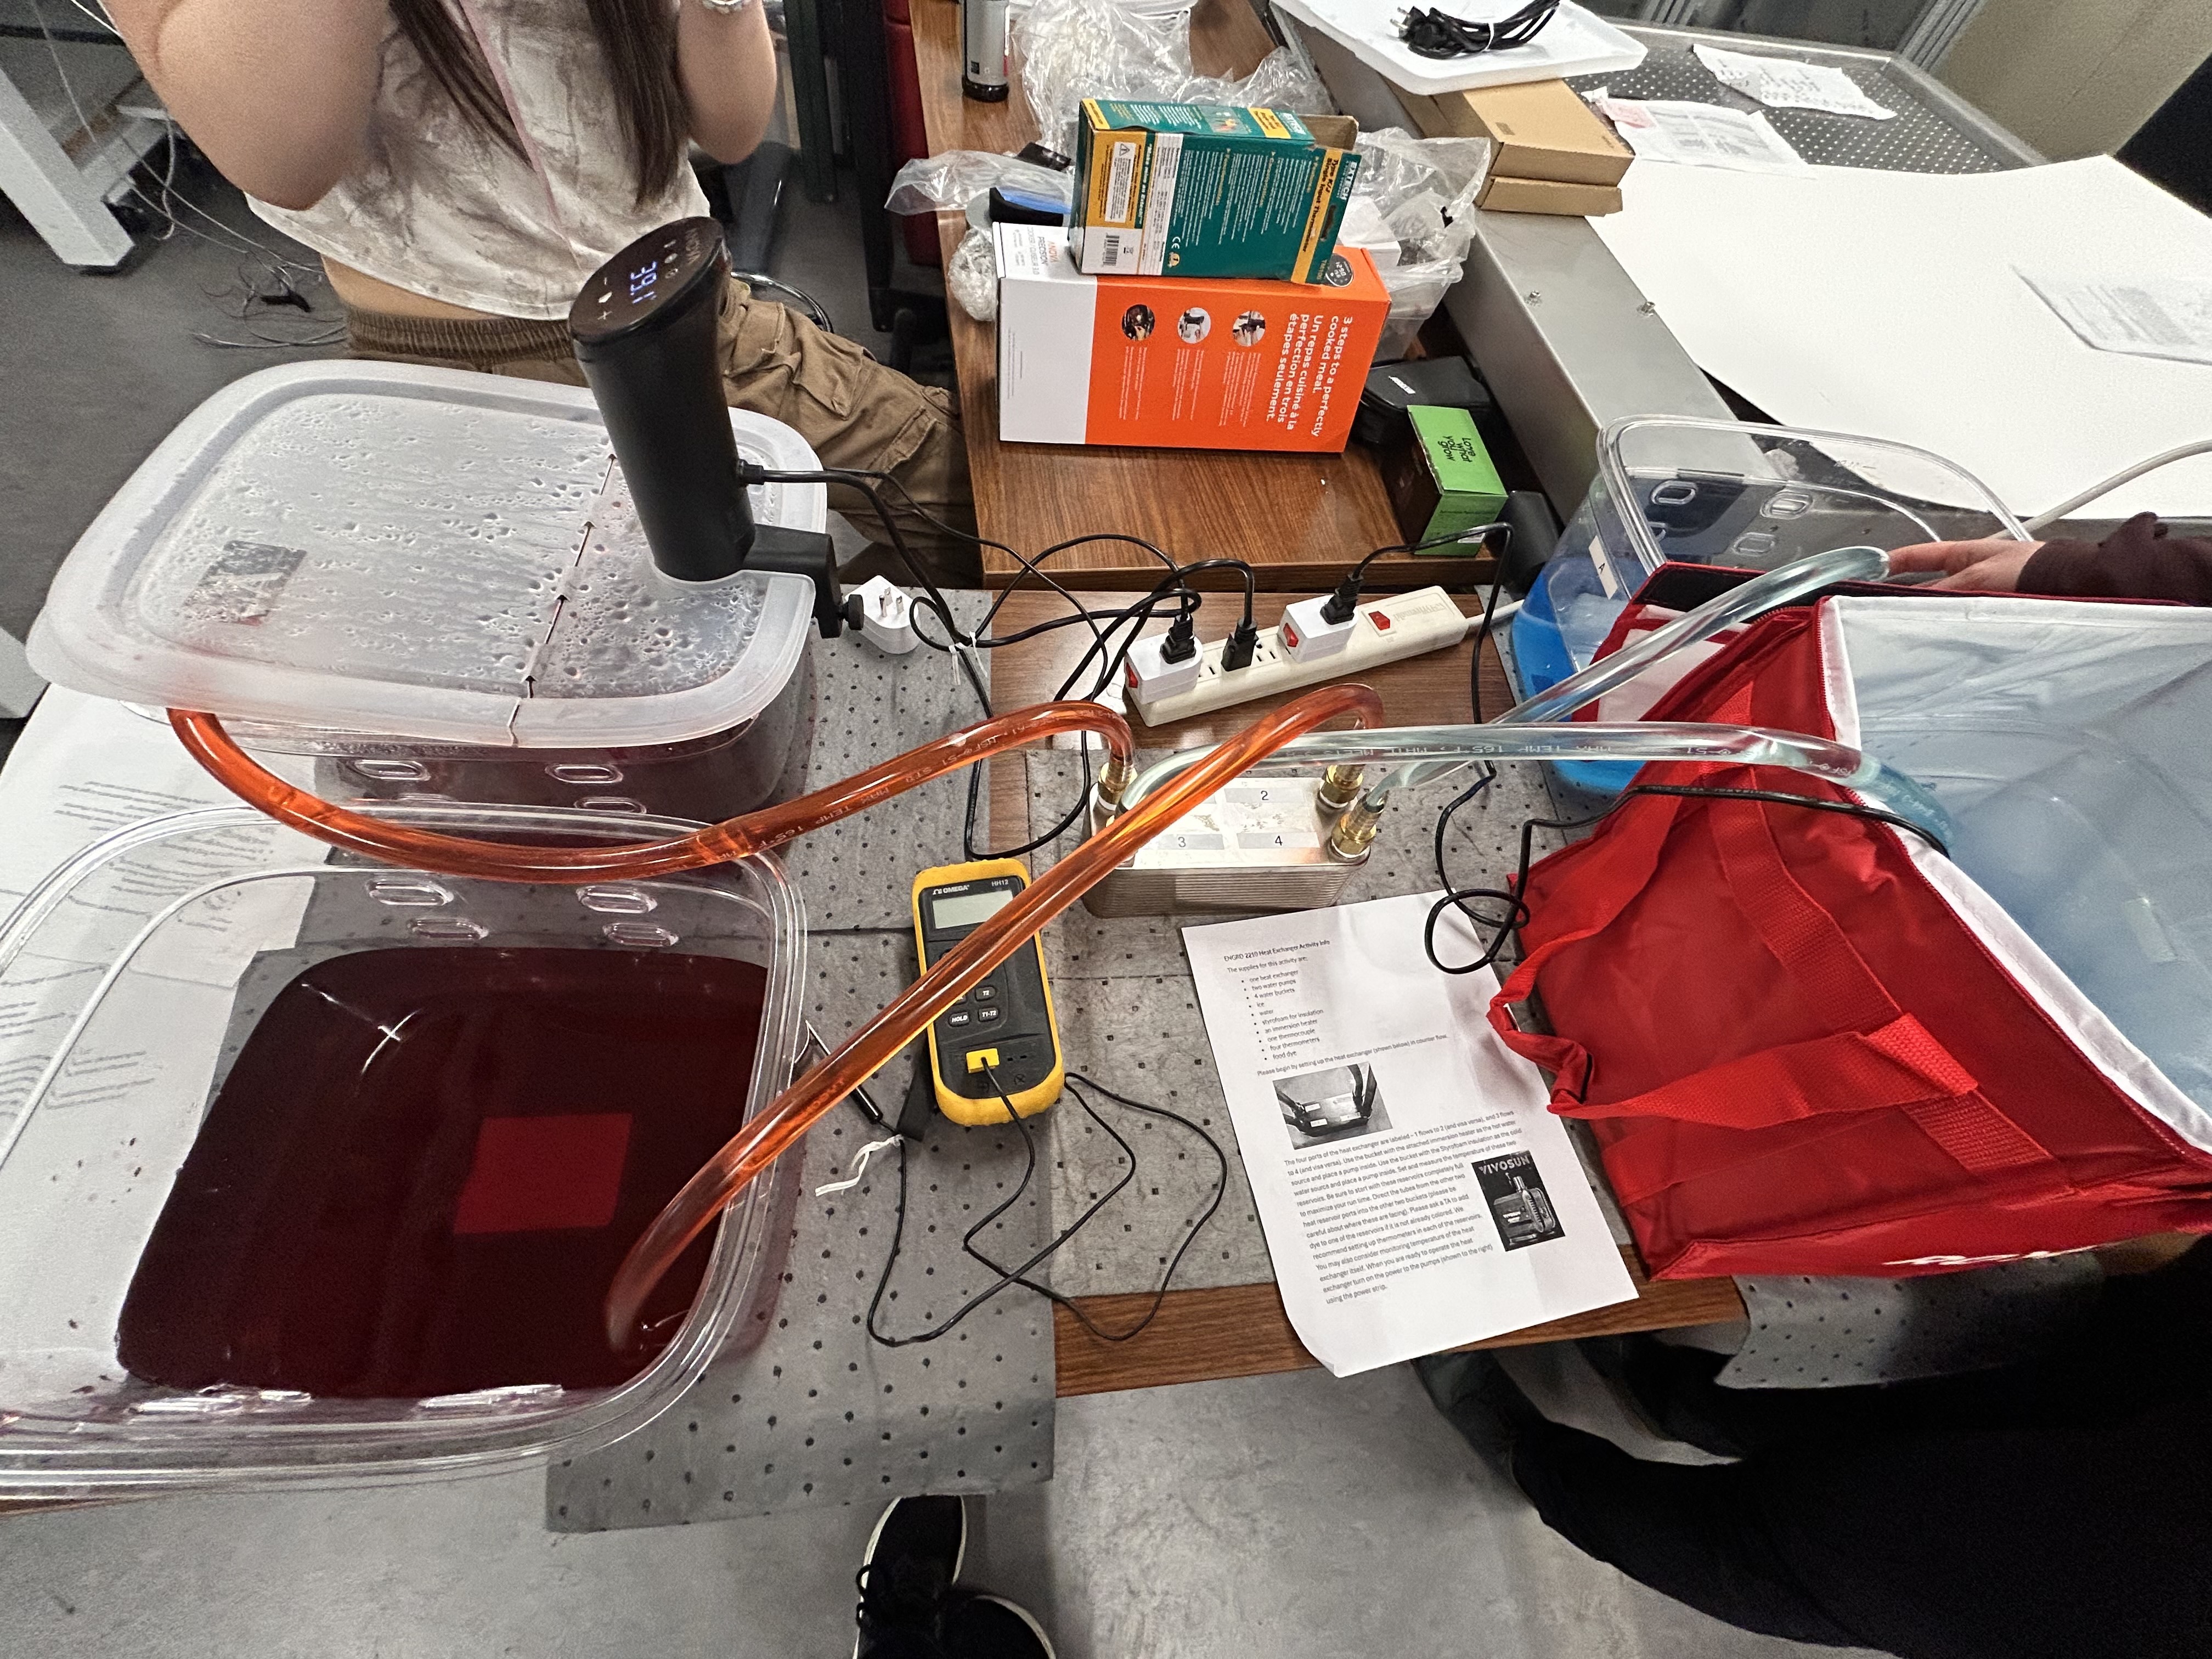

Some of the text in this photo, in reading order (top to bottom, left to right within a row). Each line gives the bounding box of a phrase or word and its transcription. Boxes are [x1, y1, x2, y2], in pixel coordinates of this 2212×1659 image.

[1330, 160, 1339, 177] Type
[1341, 161, 1358, 200] EXTECH
[1302, 158, 1332, 252] Single Input Thermometer
[1312, 315, 1324, 332] Un
[1343, 316, 1353, 324] 3
[1333, 326, 1348, 360] steps
[1302, 335, 1317, 369] repas
[1312, 316, 1340, 394] cooked meal.
[1266, 313, 1299, 422] étapes seulement.
[1277, 314, 1310, 423] perfection en trois
[1328, 362, 1340, 375] to
[1292, 370, 1310, 410] cuisiné
[1311, 386, 1333, 437] perfectly
[1286, 420, 1298, 430] la
[1438, 441, 1456, 461] grow
[1442, 436, 1458, 450] you
[1462, 438, 1476, 457] Love
[1456, 443, 1472, 462] what
[1598, 563, 1605, 574] A
[1519, 745, 1561, 753] TEMP
[1261, 790, 1268, 801] 2
[816, 805, 854, 825] TEMP
[1178, 835, 1283, 848] 3 4
[991, 879, 1008, 887] HH12
[1223, 953, 1244, 961] ENGRD
[1272, 945, 1298, 953] Exchanger
[1272, 970, 1298, 979] exchanger
[1278, 979, 1296, 987] pumps
[1262, 1015, 1289, 1025] styrofoam
[1297, 1009, 1323, 1017] insulation
[1272, 1023, 1300, 1031] immersion
[1278, 1028, 1315, 1040] thermocouple
[1282, 1037, 1319, 1048] thermometers
[1346, 1049, 1372, 1058] exchanger
[1373, 1045, 1392, 1053] (shown
[1392, 1041, 1410, 1049] below)
[1272, 1051, 1286, 1059] food
[1477, 1155, 1531, 1176] VIVOSUN
[1312, 1246, 1347, 1260] recommend
[1347, 1241, 1368, 1251] setting
[1376, 1229, 1416, 1244] thermometers
[1423, 1224, 1437, 1232] each
[1319, 1270, 1348, 1282] exchanger
[1365, 1261, 1383, 1269] When
[1383, 1259, 1395, 1267] you
[1404, 1251, 1421, 1260] ready
[1428, 1244, 1450, 1254] operate
[1323, 1280, 1352, 1293] exchanger
[1352, 1277, 1365, 1285] turn
[1384, 1268, 1402, 1278] power
[1419, 1258, 1440, 1269] pumps
[1440, 1252, 1462, 1263] (shown
[1477, 1243, 1493, 1252] right)
[1325, 1295, 1343, 1304] using
[1353, 1288, 1371, 1298] power
